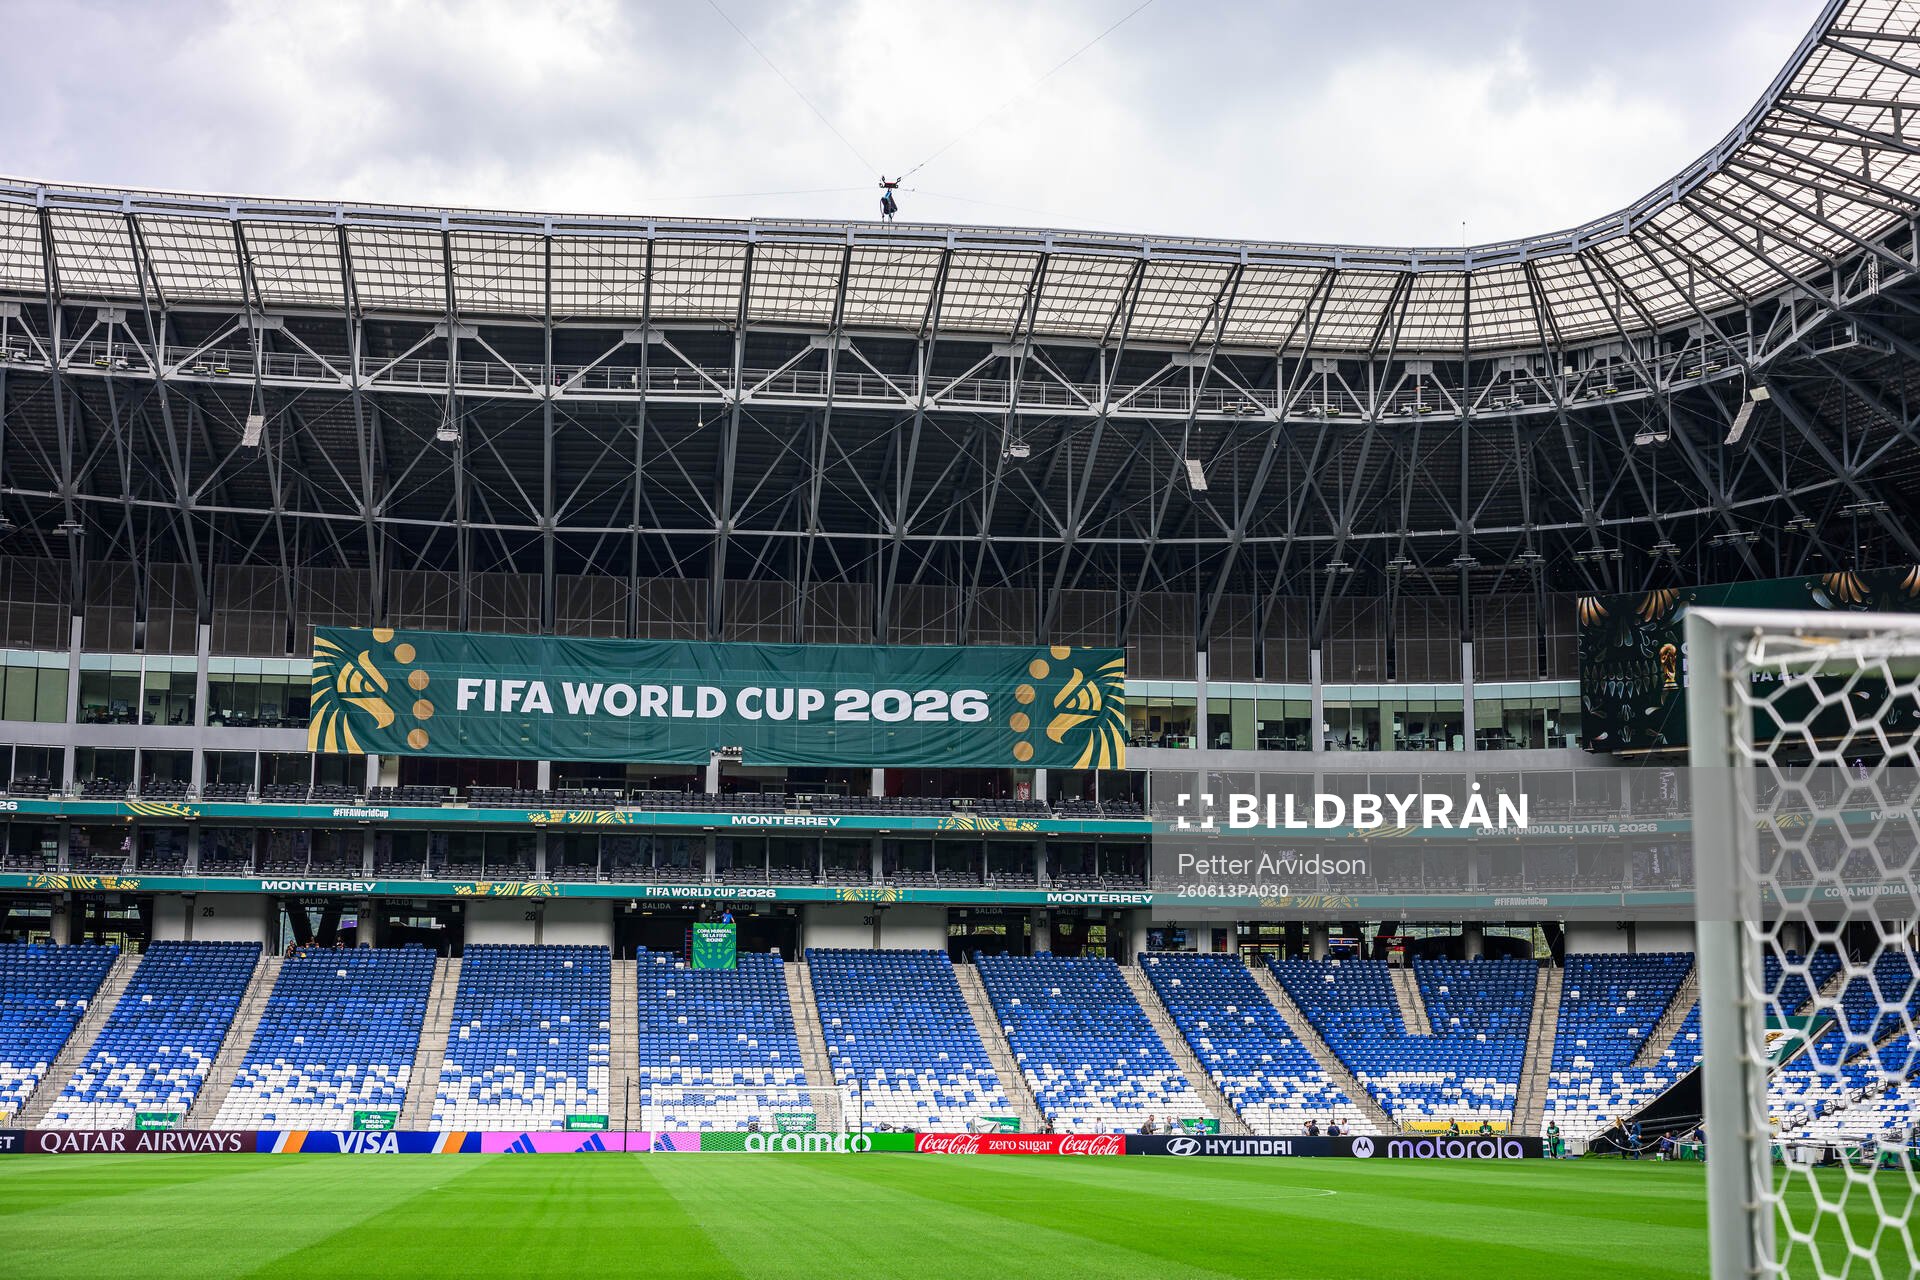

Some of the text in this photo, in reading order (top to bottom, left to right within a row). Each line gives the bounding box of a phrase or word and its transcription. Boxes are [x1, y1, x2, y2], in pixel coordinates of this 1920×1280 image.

[456, 678, 991, 722] FIFA WORLD CUP 2026
[333, 807, 389, 819] #FIFAWorldCup
[731, 815, 841, 827] MONTERREY
[1476, 823, 1658, 836] COPA MUNDIAL DE LA FIFA 2026
[261, 880, 377, 892] MONTERREY
[646, 887, 777, 898] FIFA WORLD CUP 2026
[1046, 892, 1153, 905] MONTERREY
[1494, 896, 1548, 907] #FIFAWorldCup
[202, 906, 215, 918] 26
[525, 912, 536, 921] 28
[864, 916, 874, 926] 30
[0, 1136, 15, 1149] T
[40, 1132, 242, 1153] QATAR AIRWAYS
[331, 1131, 399, 1154] VISA
[744, 1131, 872, 1153] aramco
[917, 1133, 980, 1155] Coca-Cola
[988, 1139, 1053, 1155] zero sugar
[1058, 1133, 1120, 1156] Coca-Cola
[1205, 1139, 1292, 1155] HYUNDAI
[1388, 1137, 1524, 1159] motorola
